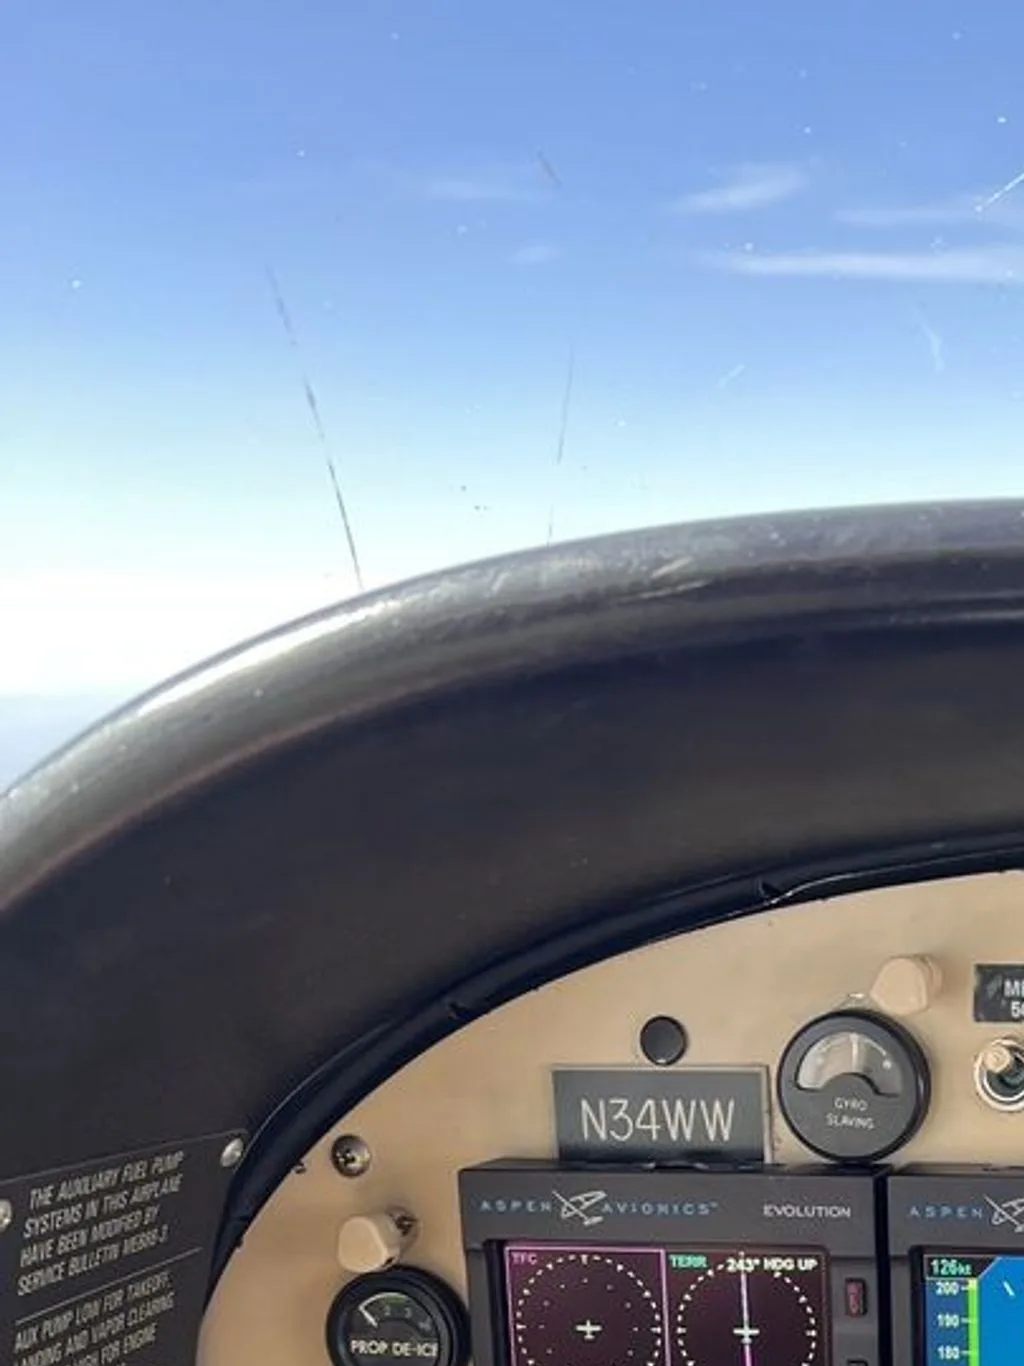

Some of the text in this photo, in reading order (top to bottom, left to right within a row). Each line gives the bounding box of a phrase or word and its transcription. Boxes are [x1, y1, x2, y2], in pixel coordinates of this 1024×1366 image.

[834, 1096, 869, 1111] GYRO
[580, 1098, 735, 1143] N34WW
[826, 1114, 875, 1130] SLAVING
[480, 1200, 552, 1213] ASPEN
[763, 1204, 851, 1218] EVOLUTION
[909, 1205, 984, 1219] ASPEN
[669, 1254, 708, 1269] TERR
[763, 1258, 818, 1272] HDG UP
[935, 1281, 961, 1296] 200
[351, 1339, 388, 1355] PROP
